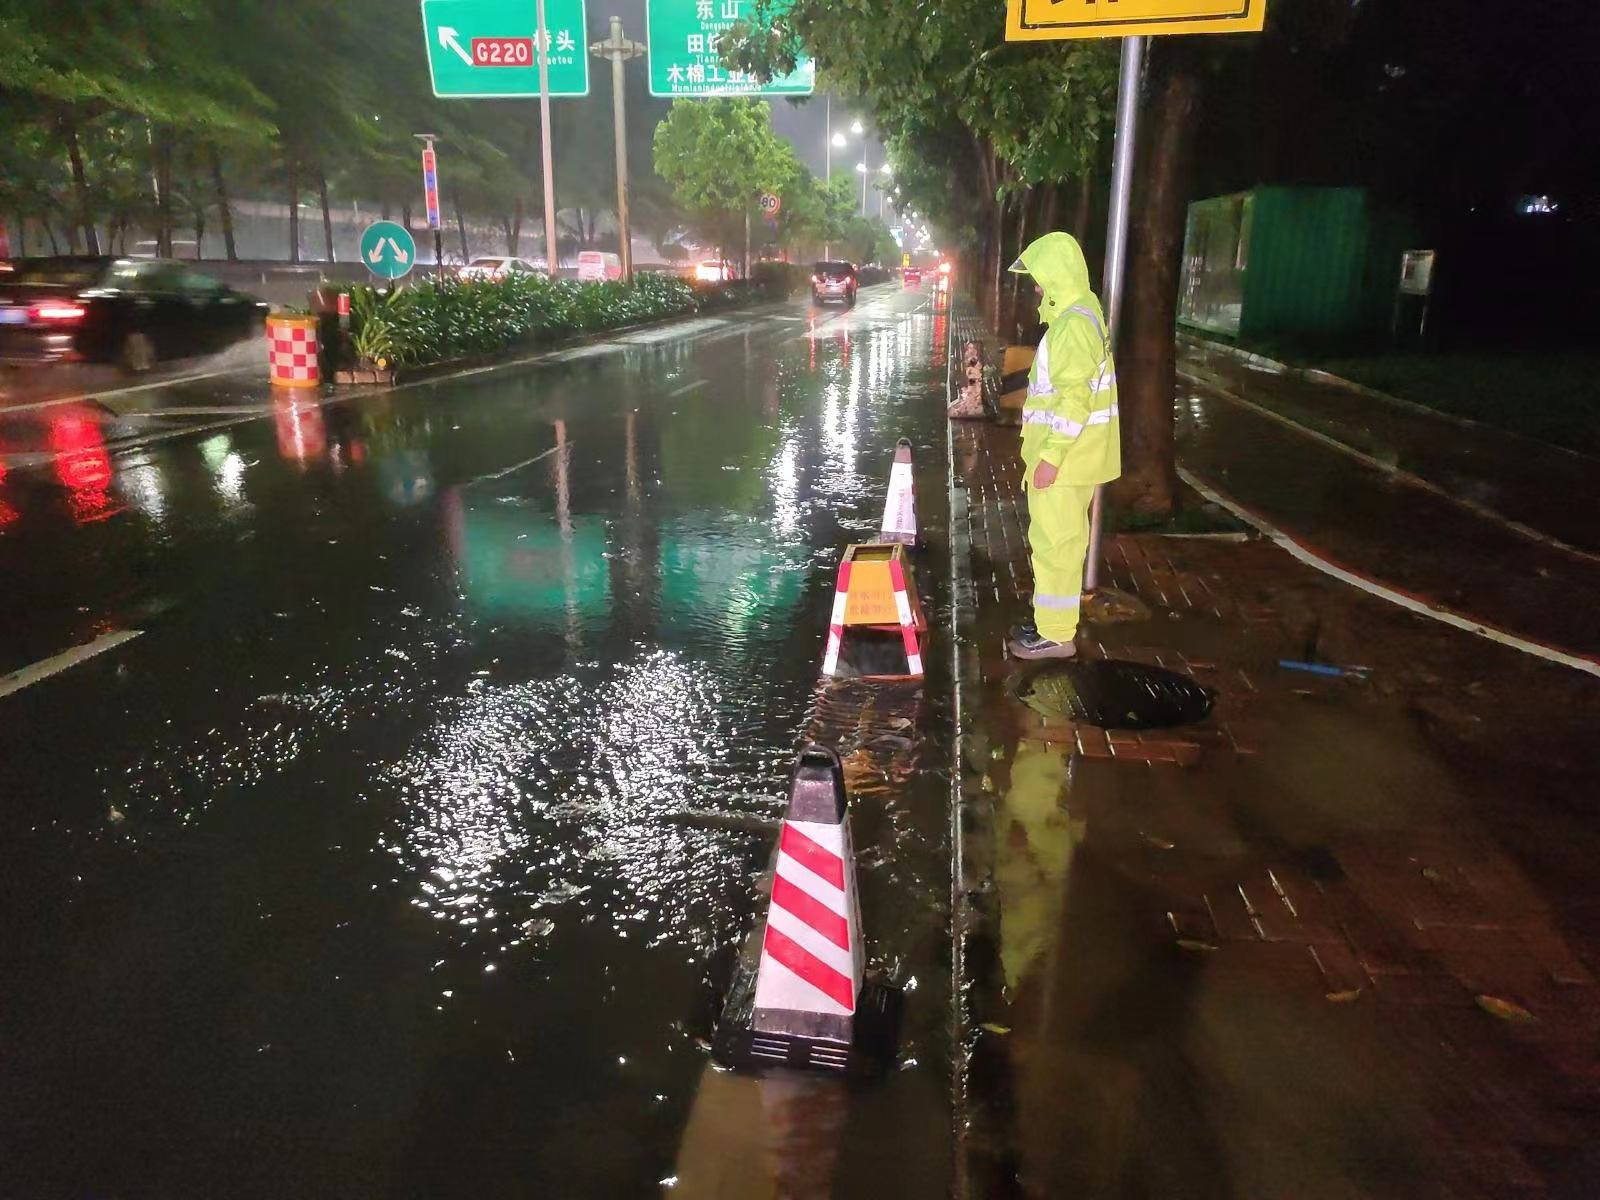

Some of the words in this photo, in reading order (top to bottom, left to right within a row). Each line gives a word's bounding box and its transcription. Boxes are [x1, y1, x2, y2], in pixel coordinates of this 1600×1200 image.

[695, 0, 739, 20] 东山
[476, 42, 528, 63] G220
[762, 197, 776, 208] 80
